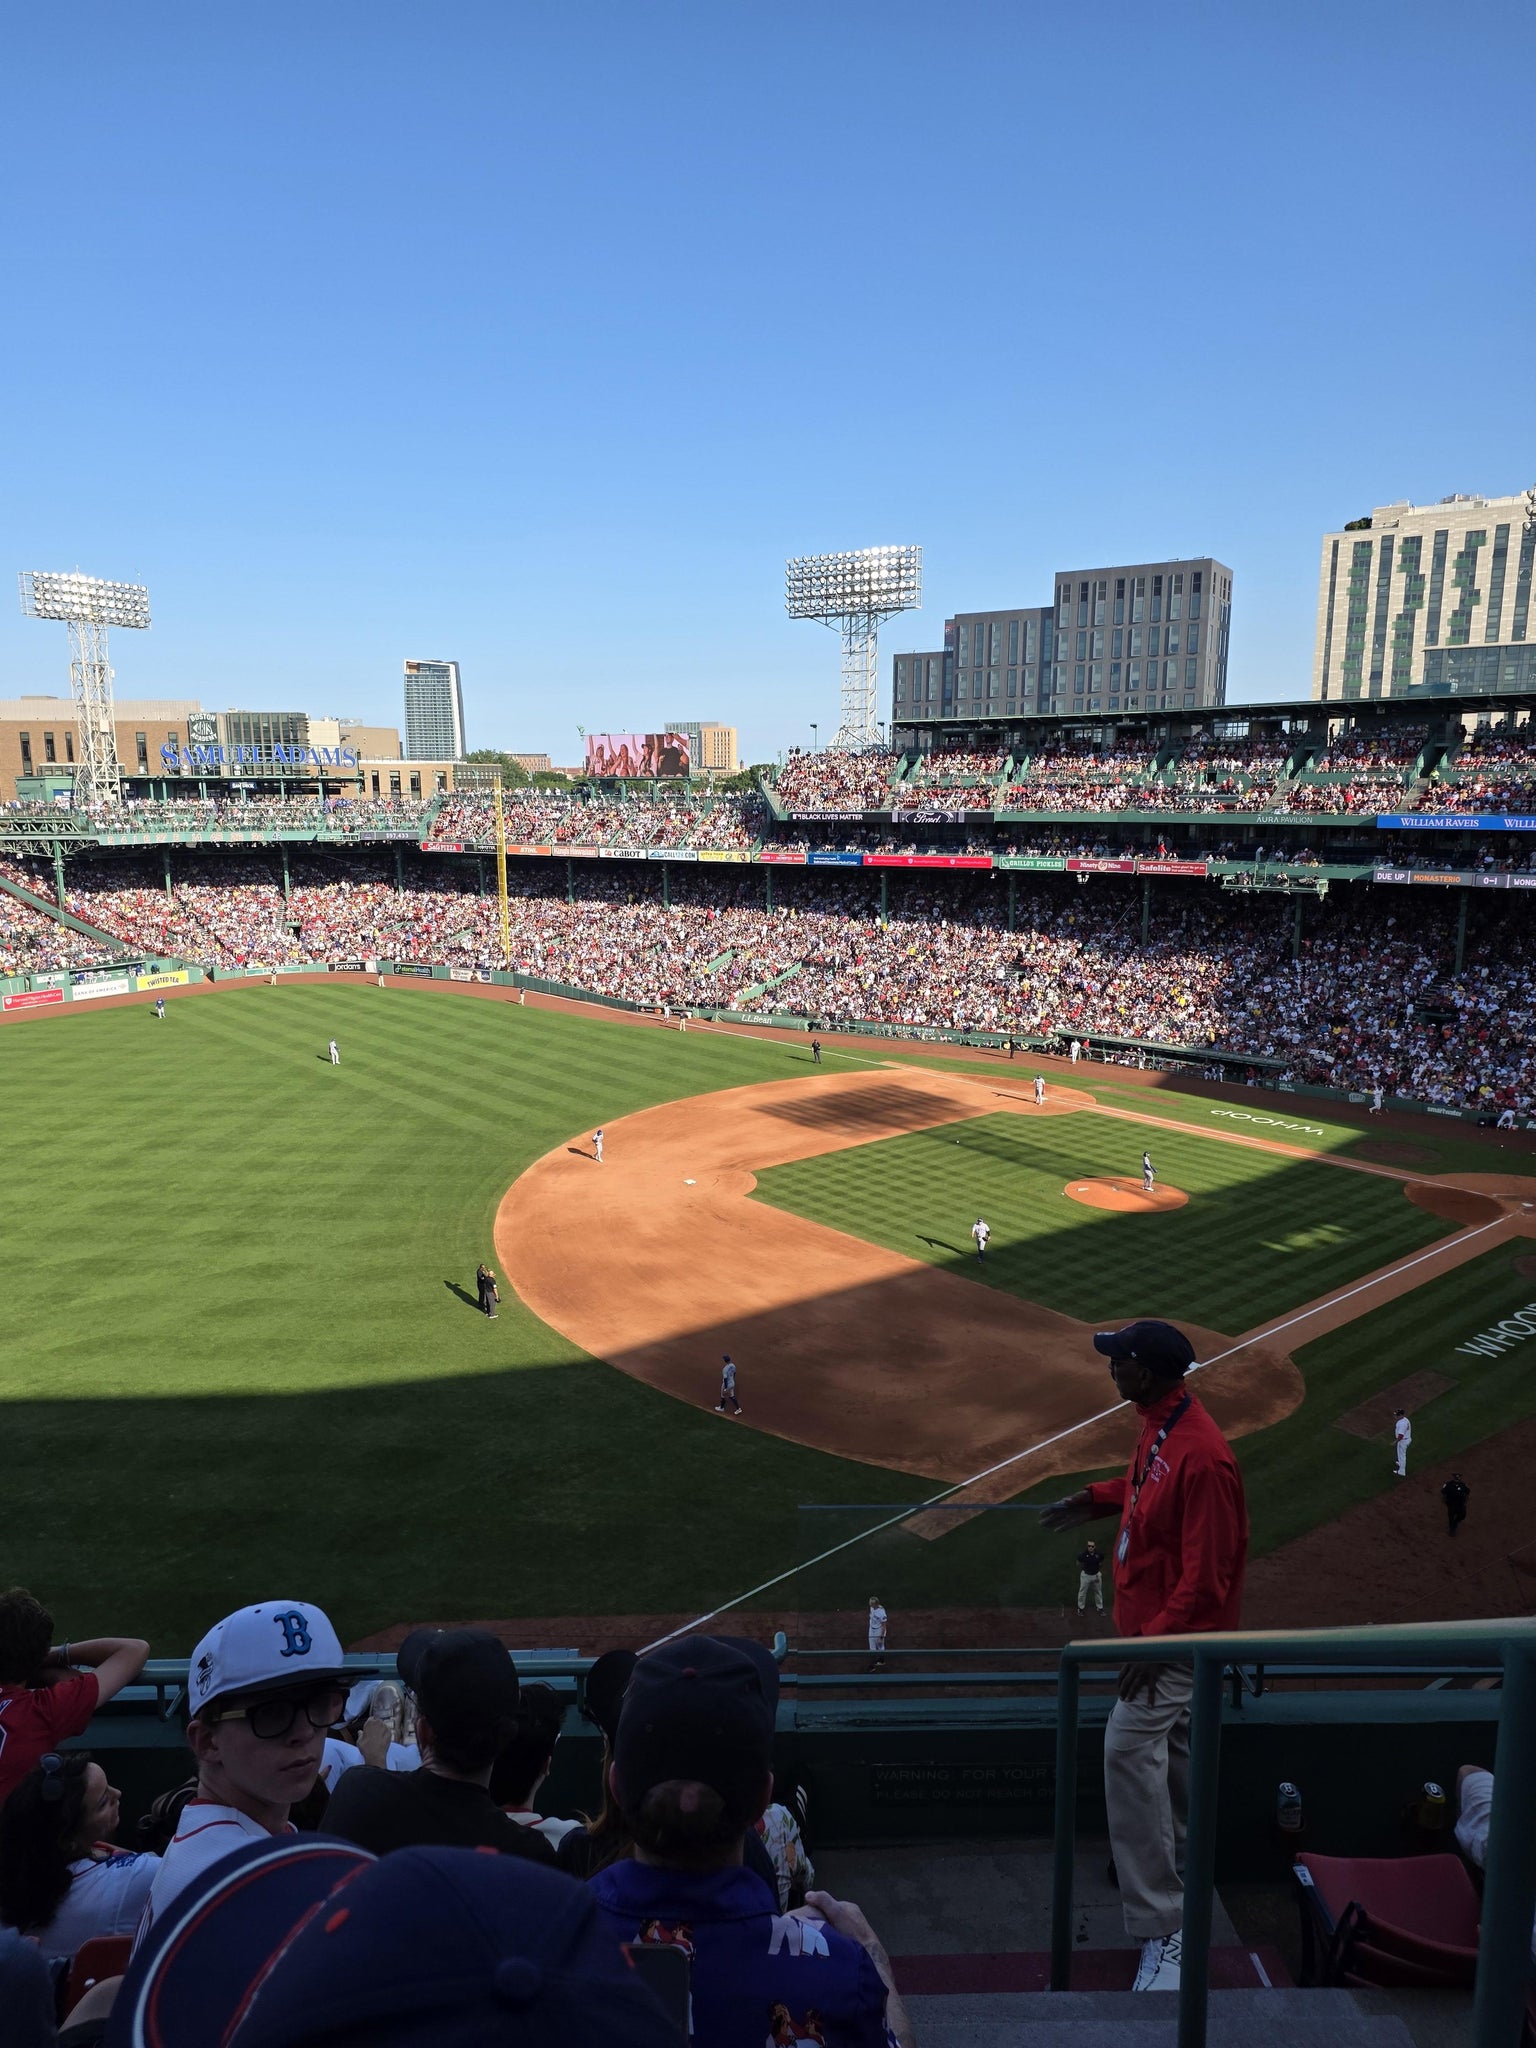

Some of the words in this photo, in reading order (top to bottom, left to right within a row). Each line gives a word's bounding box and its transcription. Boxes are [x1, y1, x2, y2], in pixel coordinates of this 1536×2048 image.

[189, 713, 216, 722] BOSTON
[190, 732, 217, 742] ACADEMY
[160, 743, 266, 769] SAMUEL
[270, 742, 357, 768] ADAMS
[914, 812, 940, 823] Ford
[1401, 818, 1443, 827] WILLIAM
[1445, 819, 1479, 827] RAVEIS
[1504, 819, 1536, 828] WILLI
[1139, 864, 1171, 872] Safelite
[1413, 875, 1461, 883] MONASTERIO
[1483, 877, 1497, 885] 0-1
[1514, 878, 1536, 886] WONG
[147, 976, 170, 988] TWISTED
[741, 1014, 772, 1024] L.L.Bean
[1426, 1106, 1462, 1117] smartwater
[1210, 1109, 1324, 1135] WHOOP
[273, 1610, 312, 1657] B
[876, 1767, 949, 1781] WARNING
[961, 1767, 996, 1780] FOR
[1002, 1766, 1048, 1780] YOUR
[876, 1789, 929, 1800] PLEASE
[932, 1789, 951, 1800] DO
[956, 1788, 982, 1799] NOT
[986, 1787, 1032, 1799] REACH
